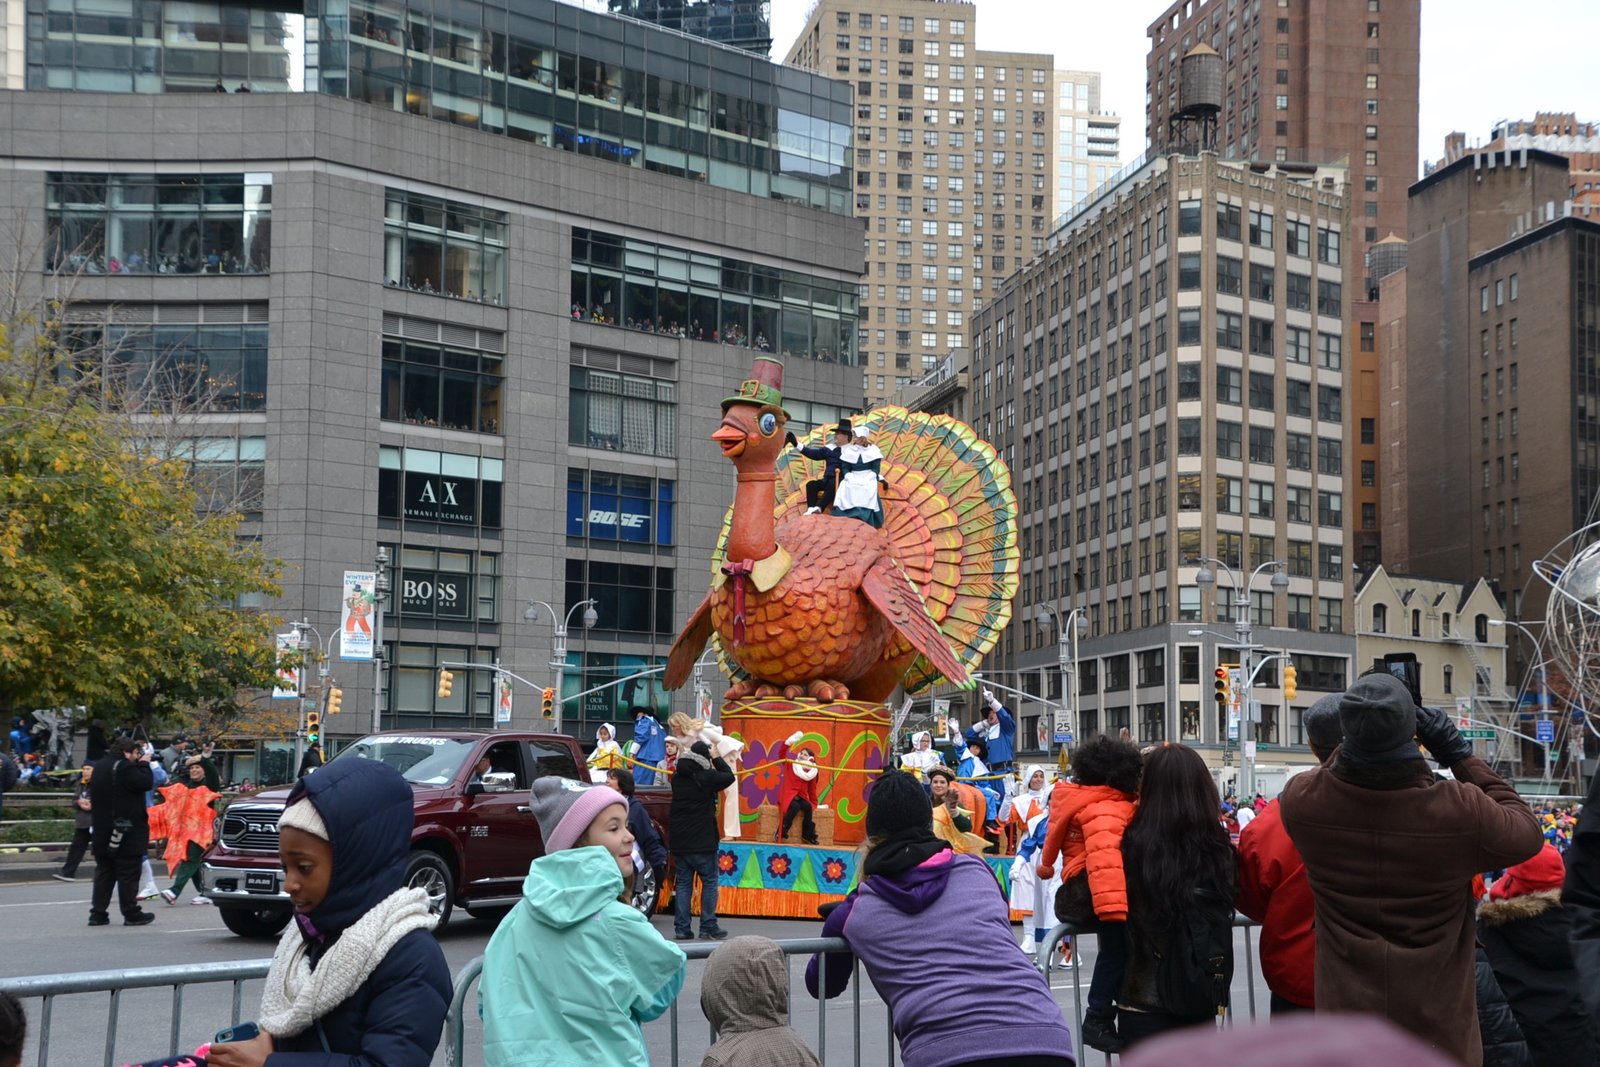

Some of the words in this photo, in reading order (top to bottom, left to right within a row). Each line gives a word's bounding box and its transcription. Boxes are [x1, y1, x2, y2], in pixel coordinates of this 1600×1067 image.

[403, 508, 433, 517] ARMANI
[435, 511, 473, 521] EXCHANGE
[586, 509, 651, 528] BOSE
[403, 579, 457, 601] BOSS
[1056, 722, 1071, 732] 25
[398, 737, 447, 745] TRUCKS
[248, 823, 279, 832] RA
